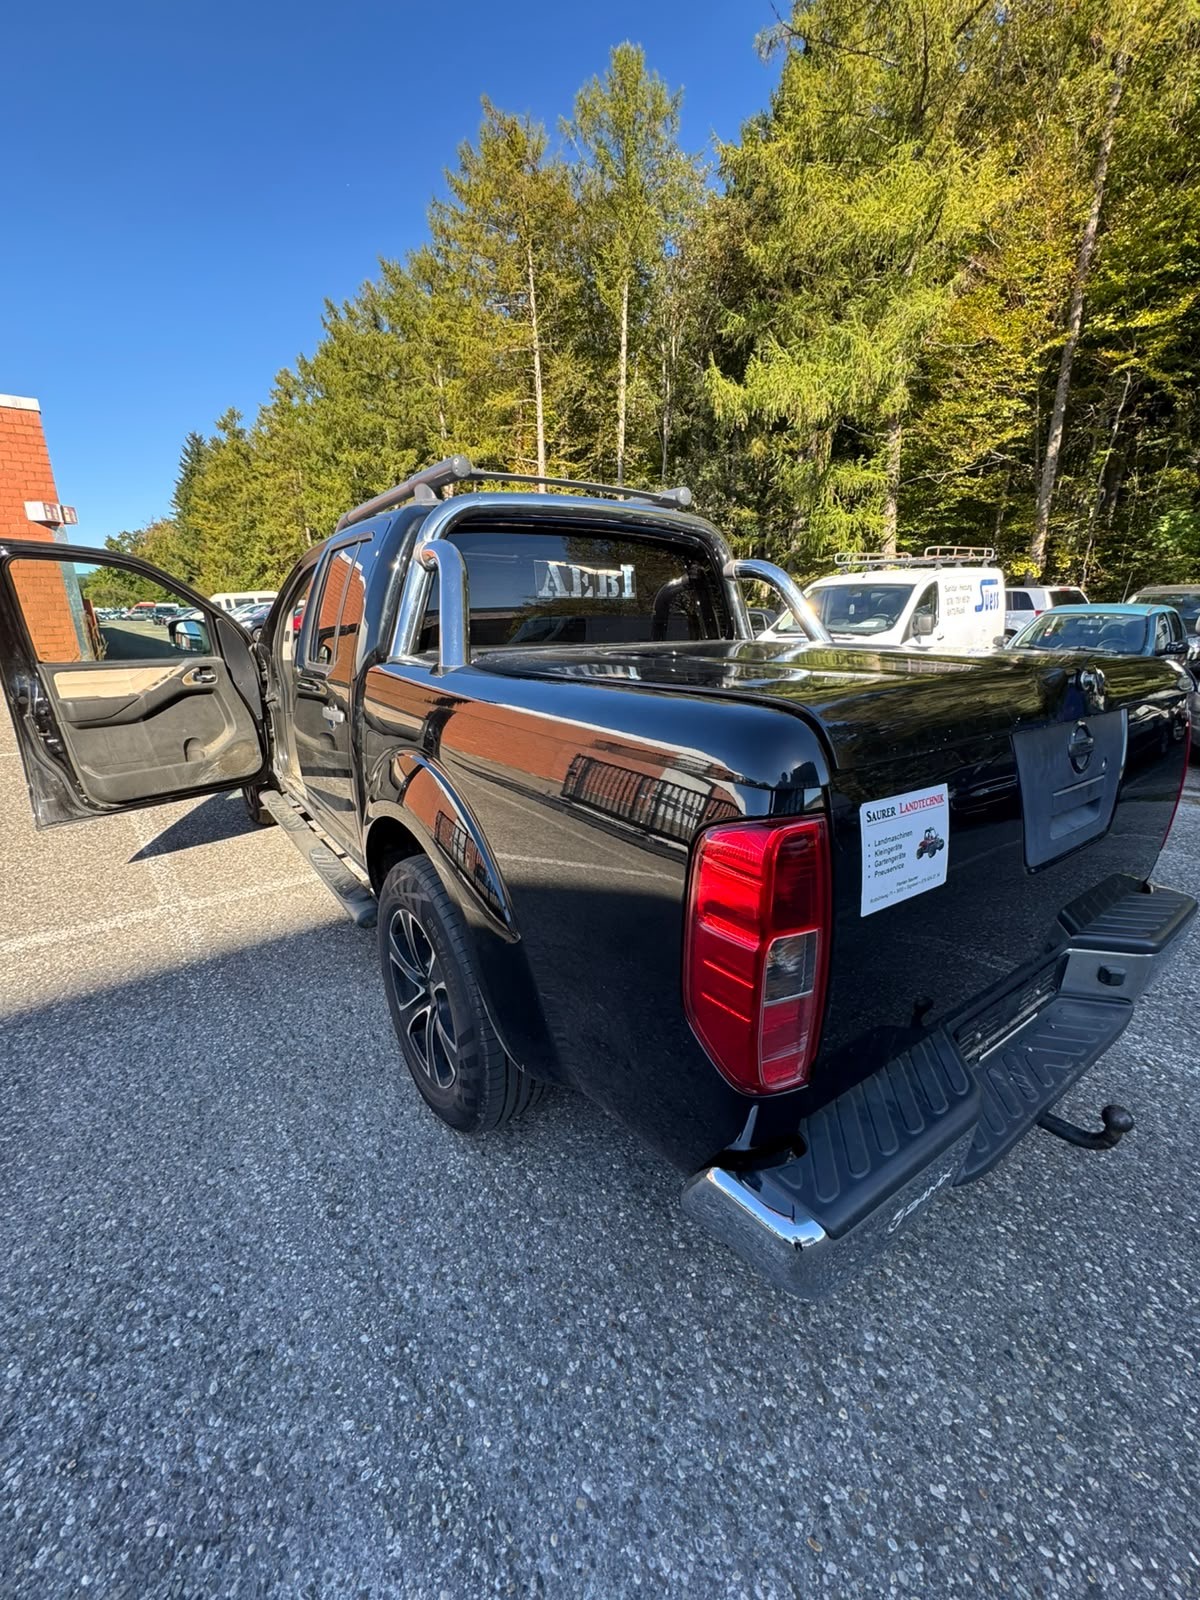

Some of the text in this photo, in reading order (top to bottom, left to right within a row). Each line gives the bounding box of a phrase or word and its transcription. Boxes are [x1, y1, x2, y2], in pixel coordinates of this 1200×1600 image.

[866, 794, 944, 822] SAURER LANDTECHNIK
[874, 830, 912, 847] Landmaschinen
[874, 843, 902, 857] Kleingeräte
[874, 852, 906, 868] Gartengeräte
